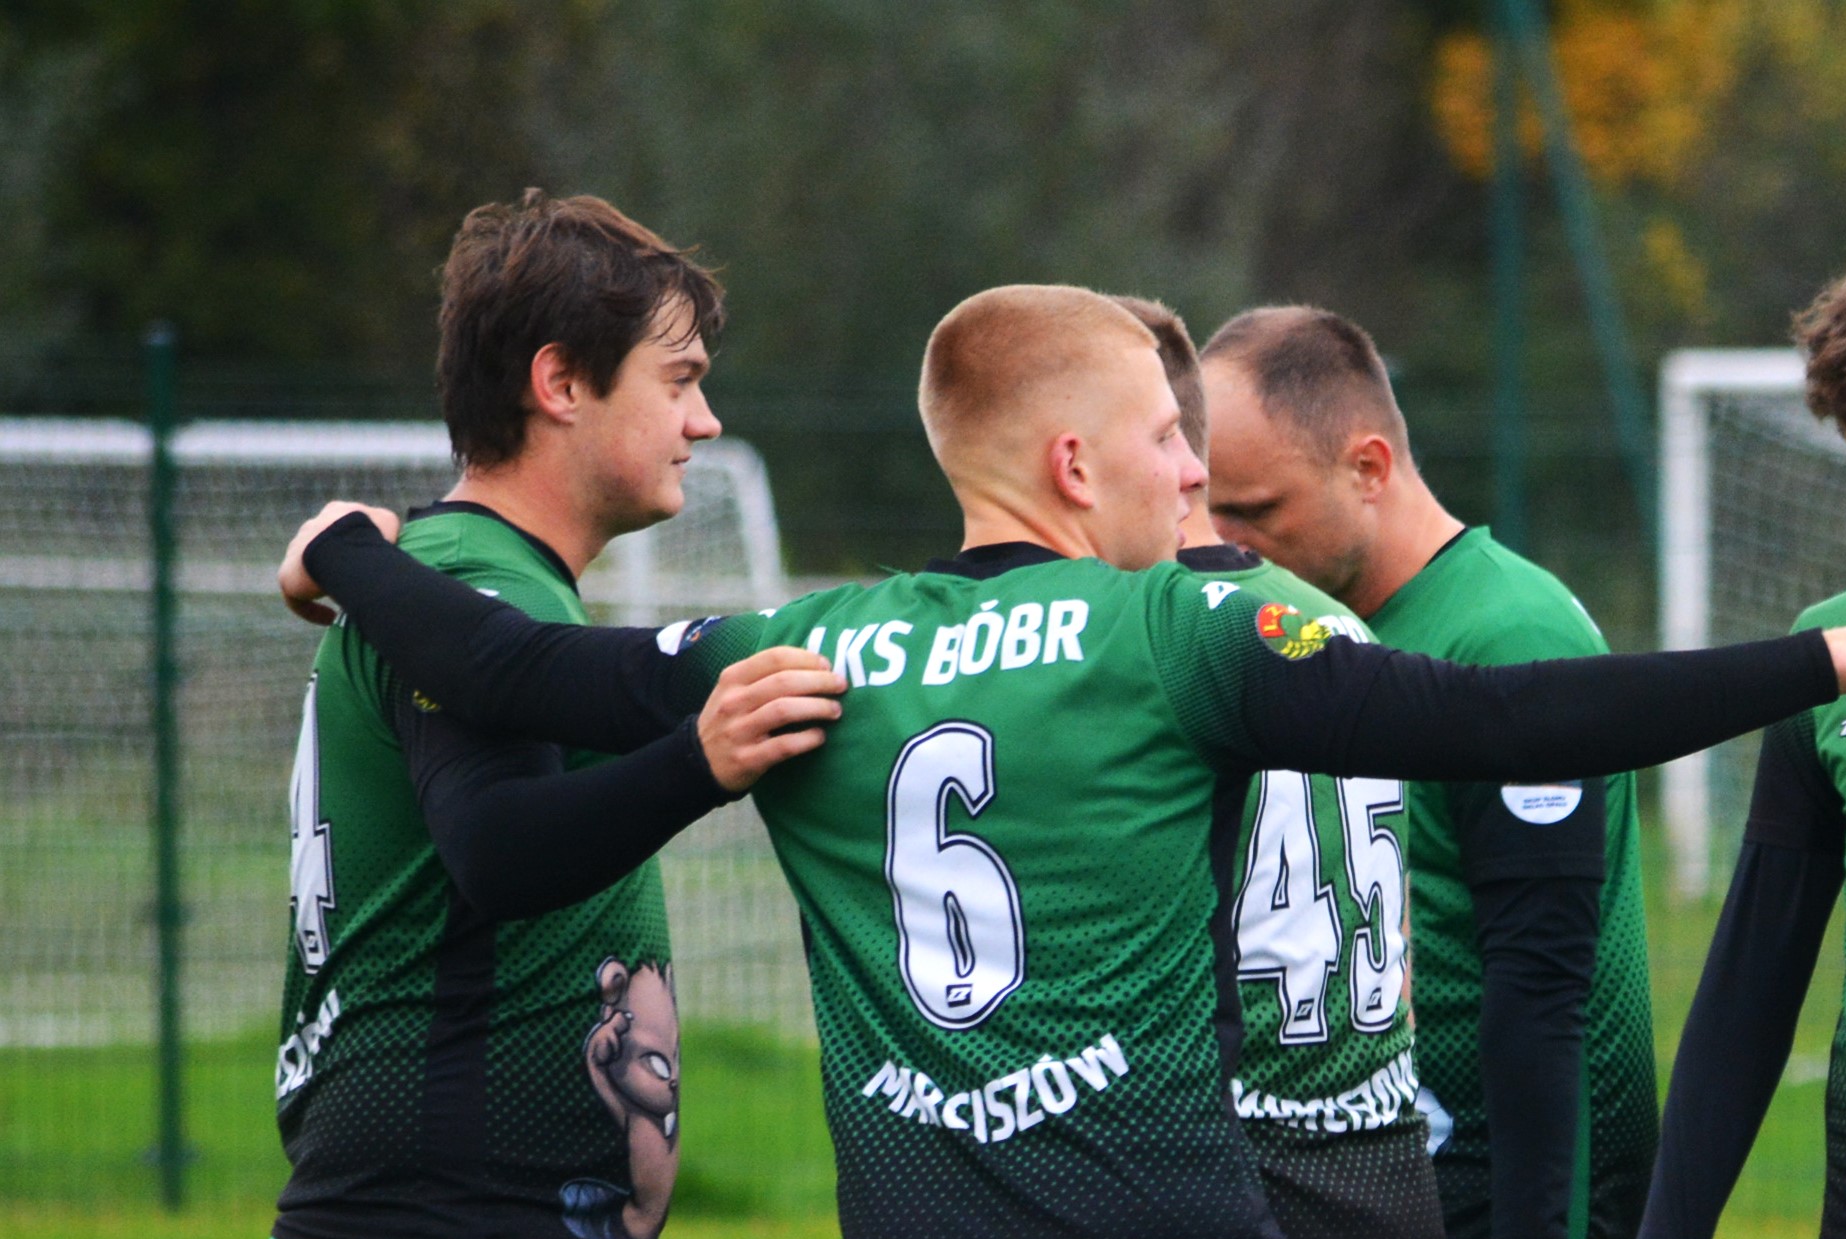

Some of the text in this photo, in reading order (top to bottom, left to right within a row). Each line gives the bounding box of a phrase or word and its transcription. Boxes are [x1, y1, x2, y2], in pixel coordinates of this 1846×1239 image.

[921, 599, 1090, 686] BÓBR
[884, 718, 1026, 1031] 6
[1231, 769, 1408, 1045] 45
